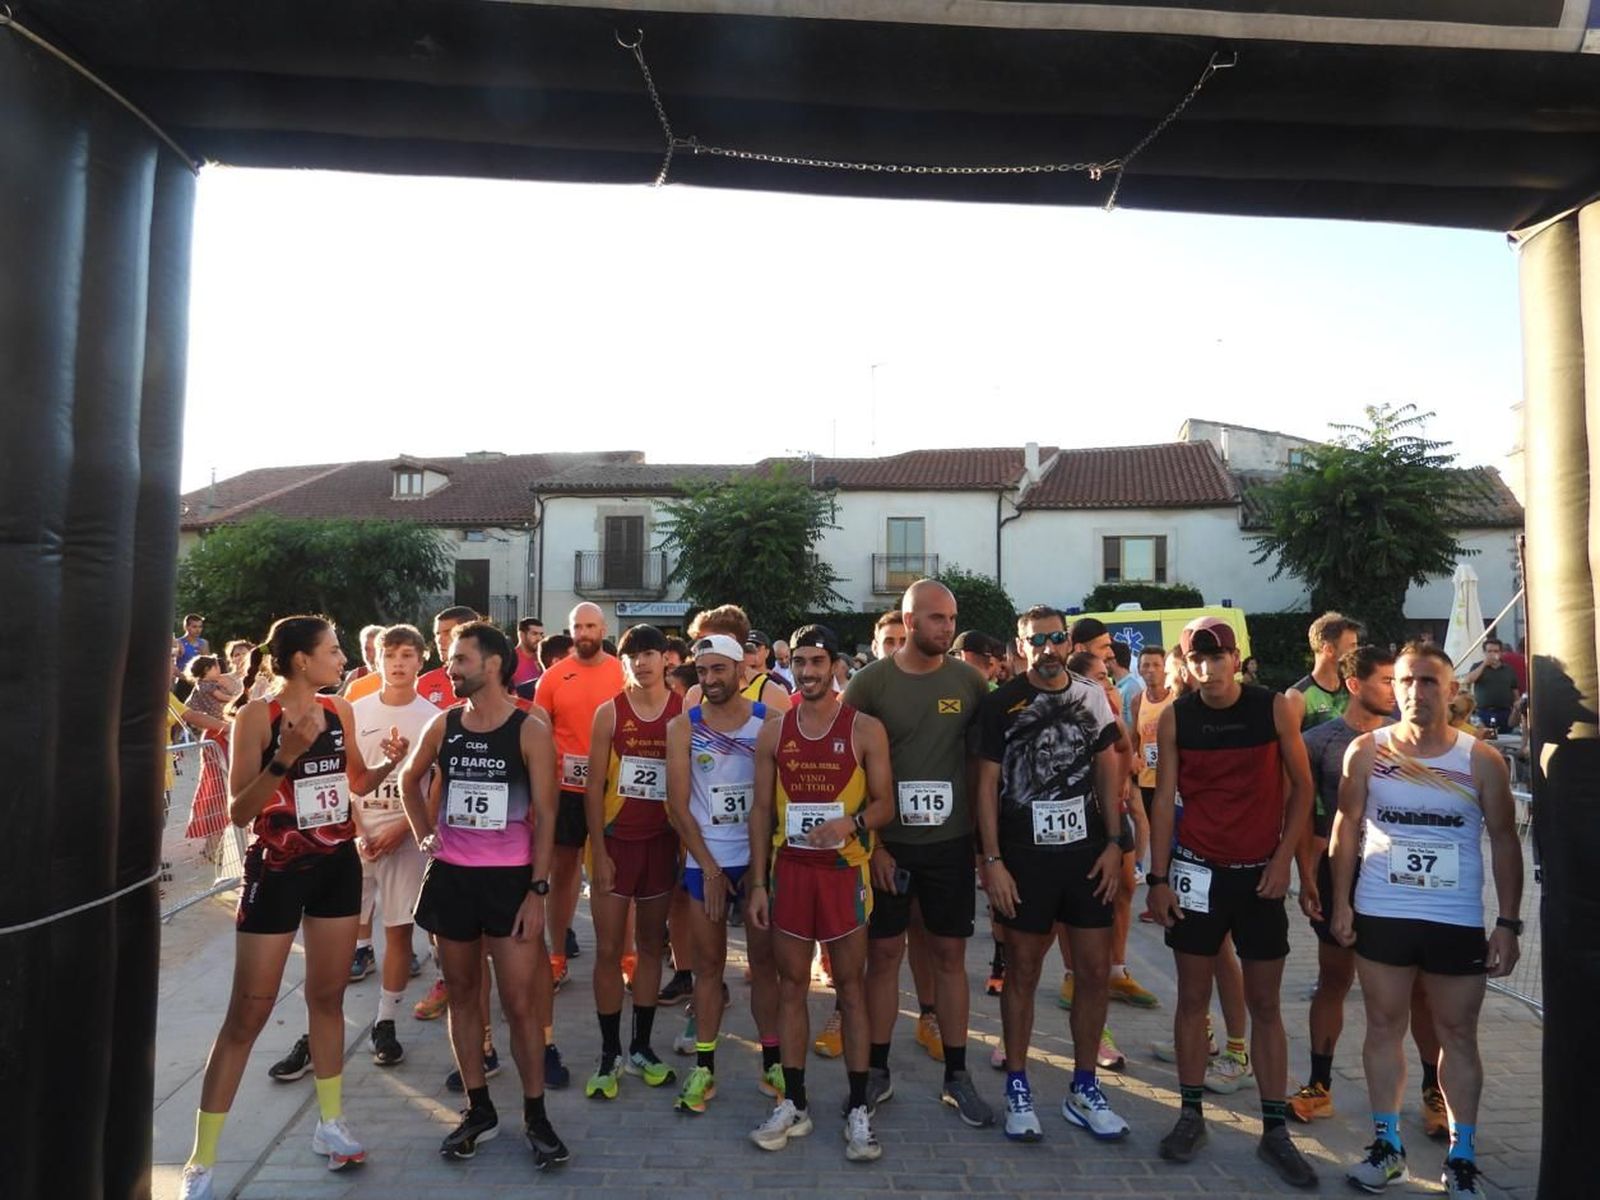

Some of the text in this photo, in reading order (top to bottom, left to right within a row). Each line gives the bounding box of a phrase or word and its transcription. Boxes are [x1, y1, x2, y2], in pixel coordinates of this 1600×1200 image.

[320, 758, 340, 772] BM
[461, 757, 506, 769] BARCO
[633, 770, 657, 785] 22
[800, 774, 826, 783] VINO
[805, 784, 834, 792] TORO
[316, 789, 339, 809] 13
[464, 796, 488, 813] 15
[724, 796, 746, 812] 31
[910, 795, 944, 810] 115
[1045, 812, 1077, 830] 110
[1407, 853, 1438, 873] 37
[1174, 874, 1191, 893] 16
